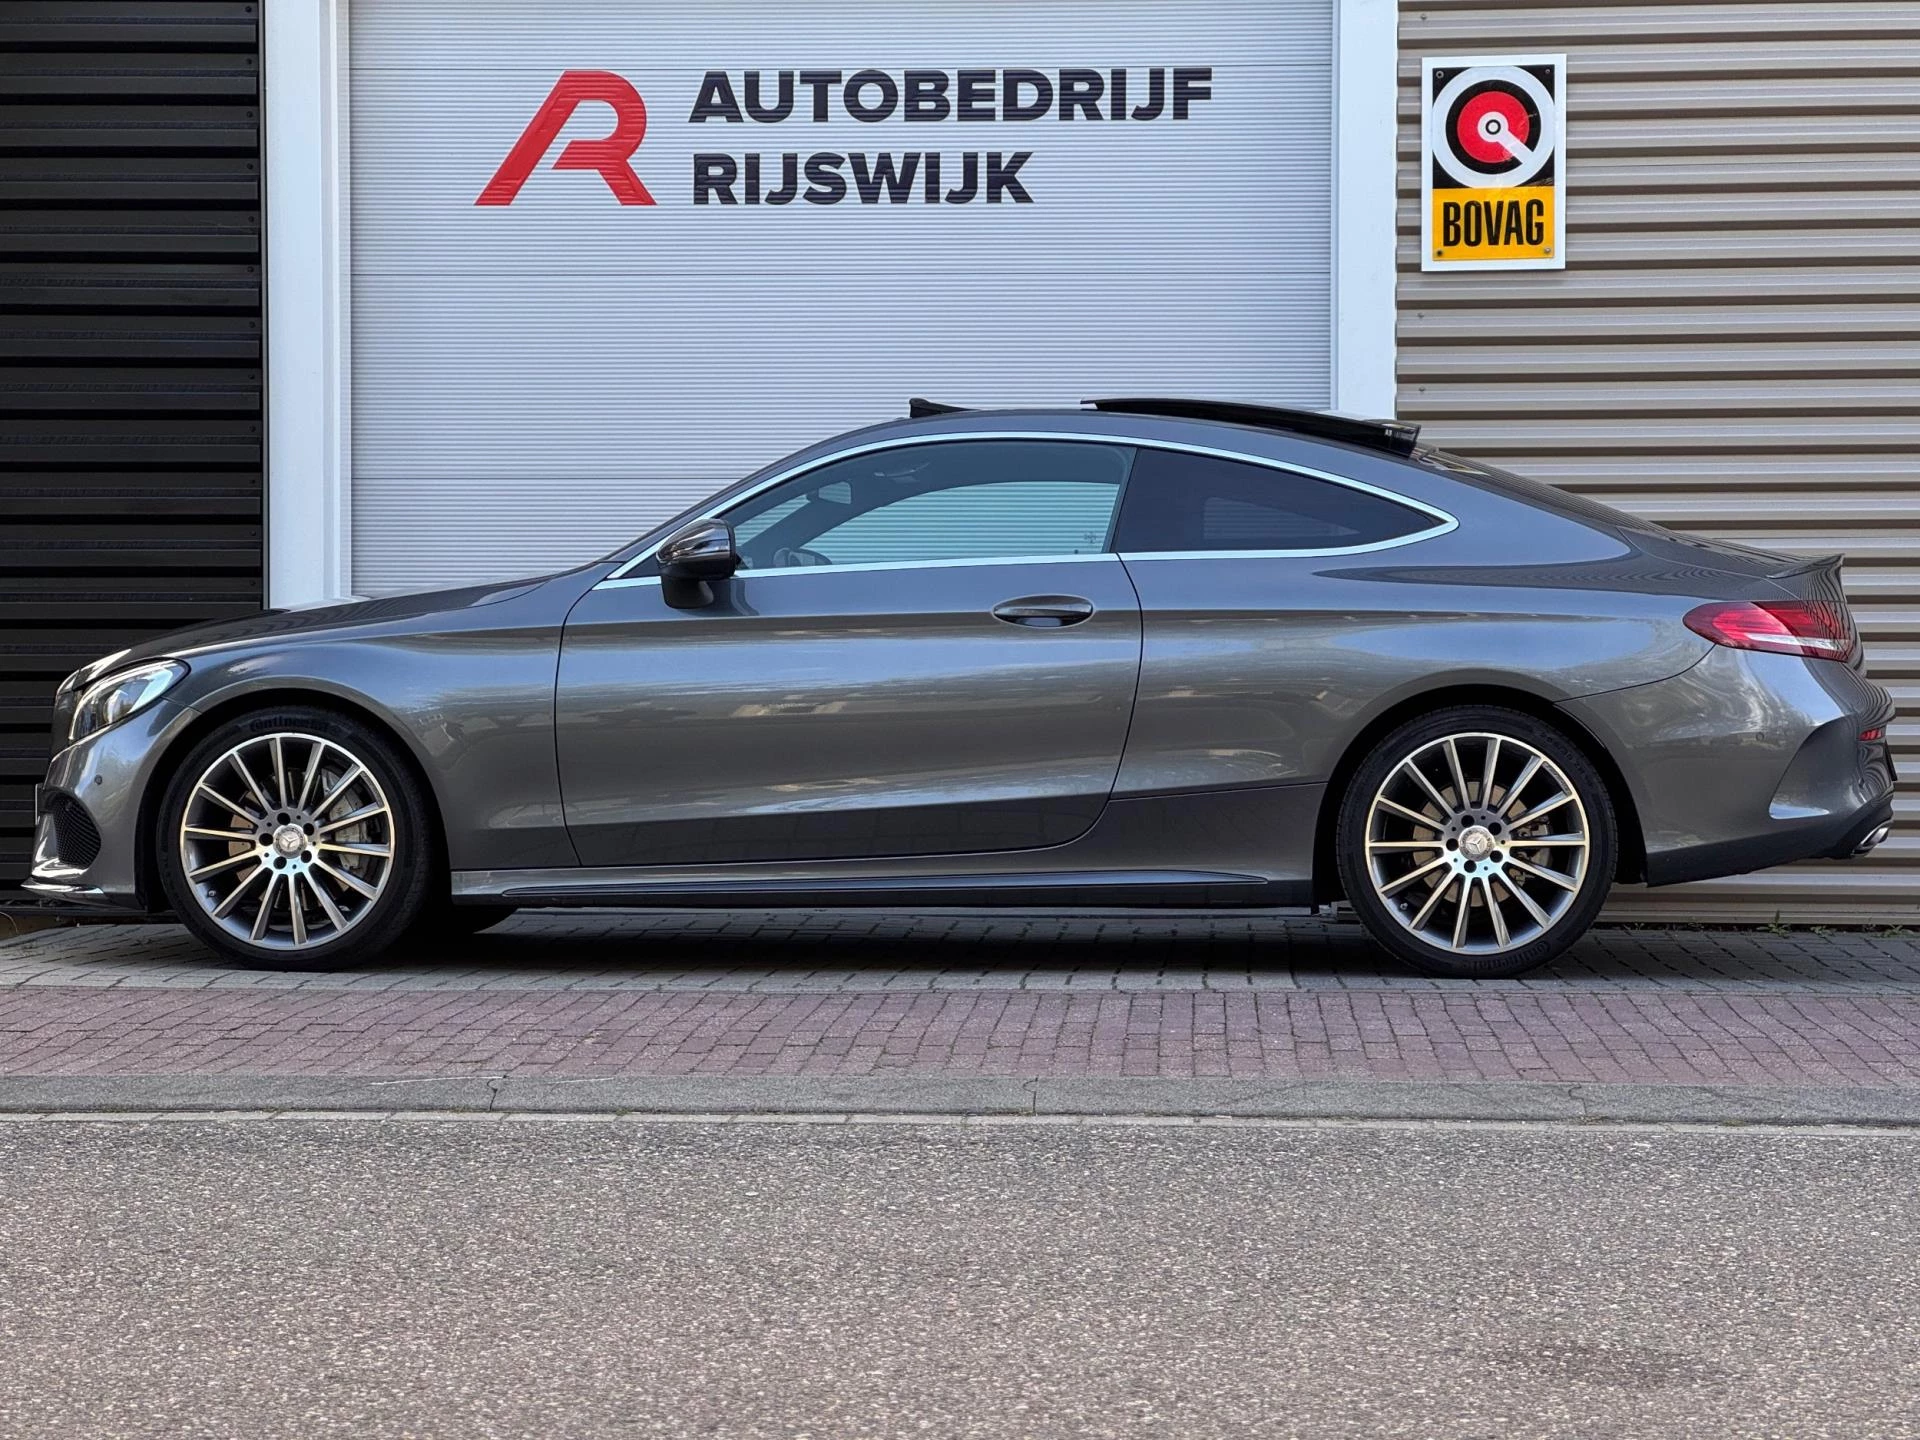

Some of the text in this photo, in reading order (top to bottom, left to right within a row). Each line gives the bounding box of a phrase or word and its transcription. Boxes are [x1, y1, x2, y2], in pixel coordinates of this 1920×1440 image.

[689, 67, 1212, 123] AUTOBEDRIJF
[693, 151, 1034, 206] RIJSWIJK
[1443, 199, 1545, 247] BOVAG
